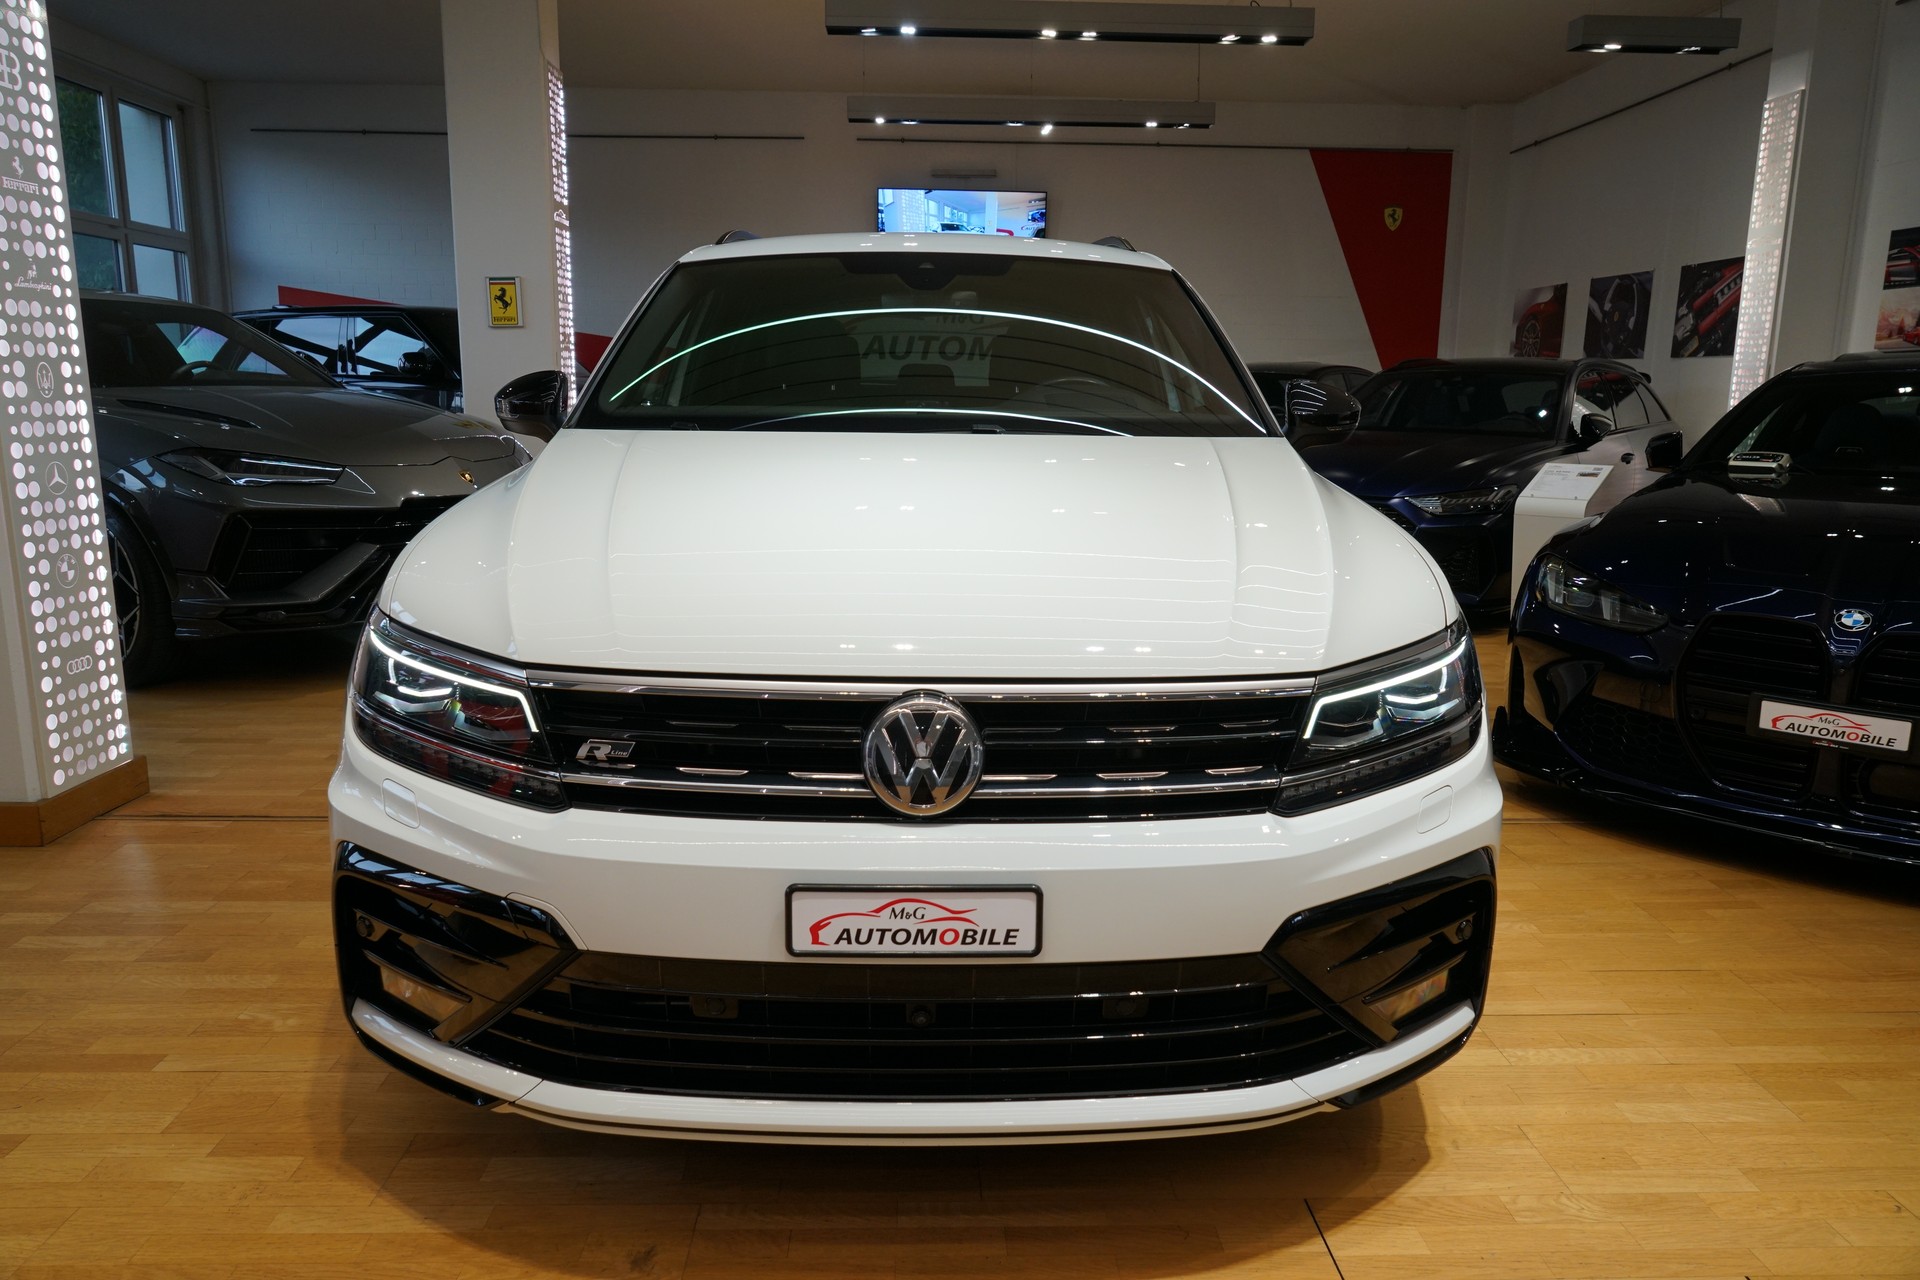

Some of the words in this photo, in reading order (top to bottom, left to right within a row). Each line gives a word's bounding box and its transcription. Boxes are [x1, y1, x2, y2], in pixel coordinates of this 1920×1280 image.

[2, 177, 39, 195] Ferrari
[1817, 716, 1841, 726] M&G
[1785, 722, 1897, 747] AUTOMOBILE
[576, 743, 612, 761] R
[888, 906, 926, 920] M&G
[834, 928, 1020, 946] AUTOMOBILE
